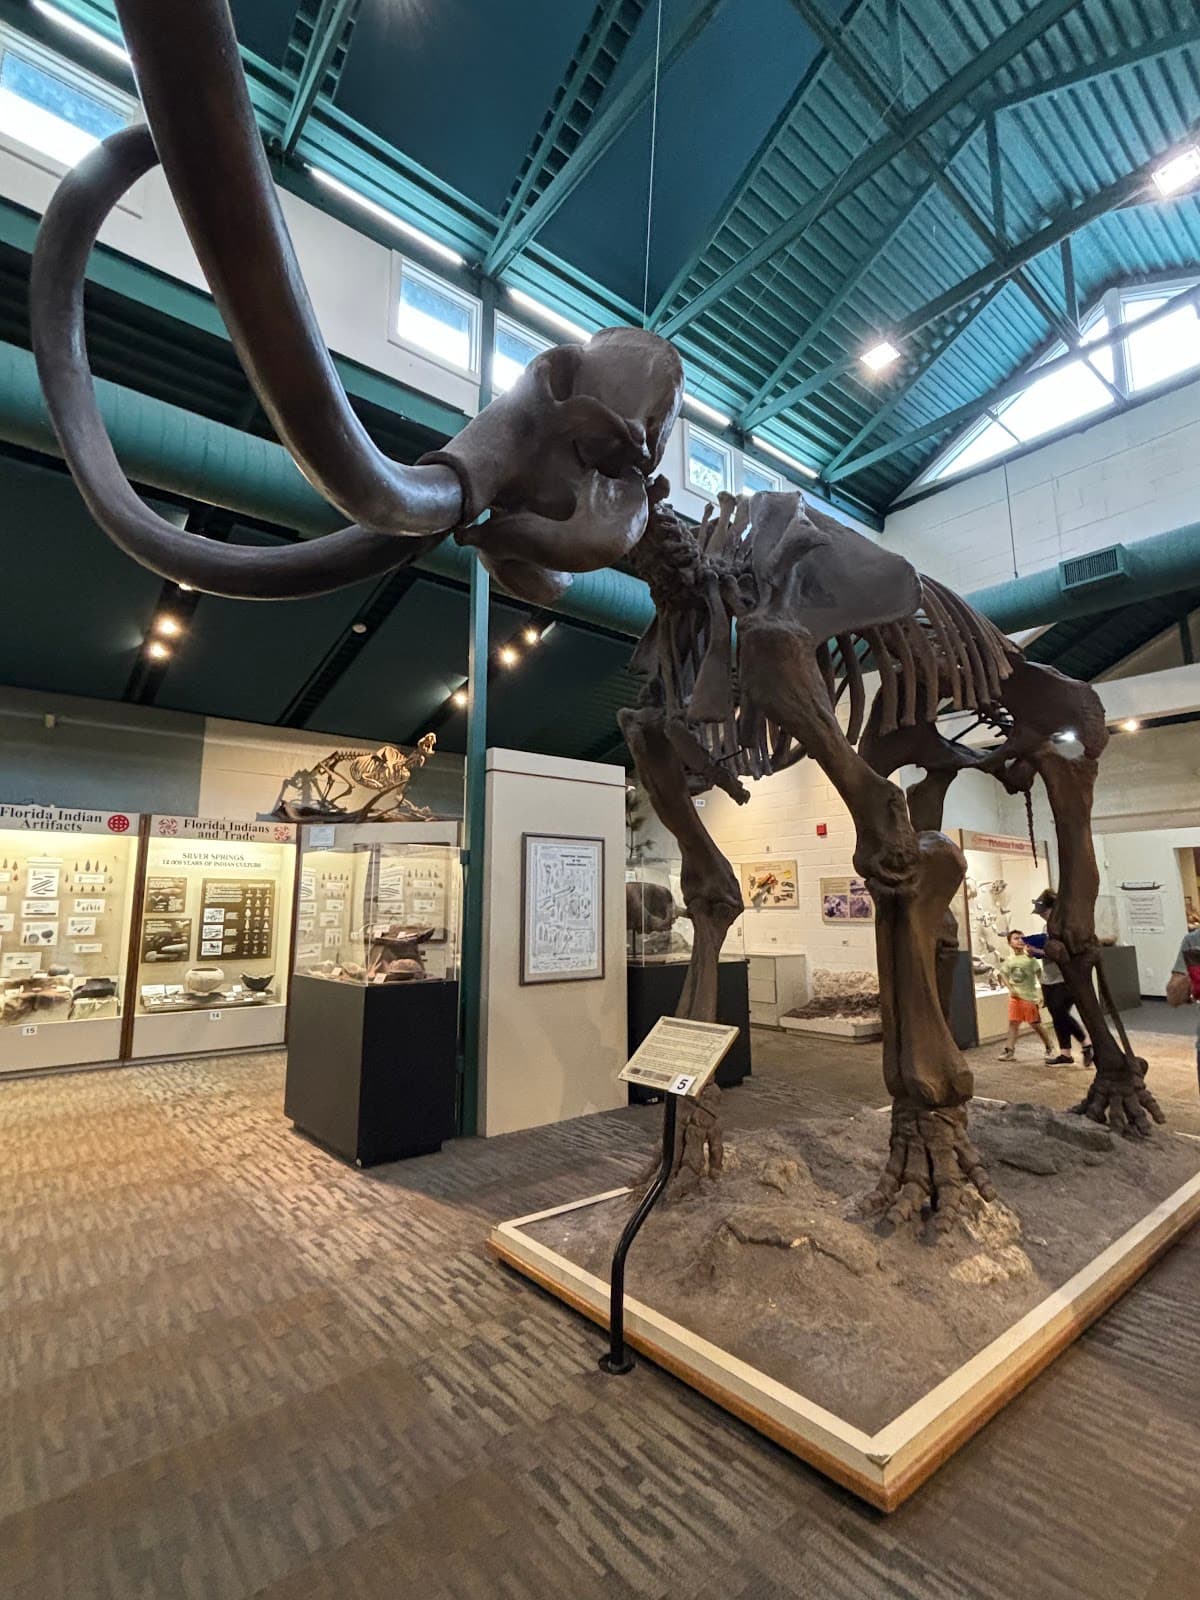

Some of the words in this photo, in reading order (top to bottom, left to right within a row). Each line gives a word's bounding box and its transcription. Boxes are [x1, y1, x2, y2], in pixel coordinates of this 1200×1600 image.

[0, 806, 53, 820] Florida
[58, 810, 102, 823] Indian
[21, 819, 82, 831] Artifacts
[184, 819, 226, 831] Florida
[230, 822, 270, 833] Indians
[198, 830, 219, 840] and
[224, 831, 255, 841] Trade
[182, 852, 209, 860] SILVER
[211, 853, 245, 861] SPRINGS
[676, 1078, 689, 1090] 5
